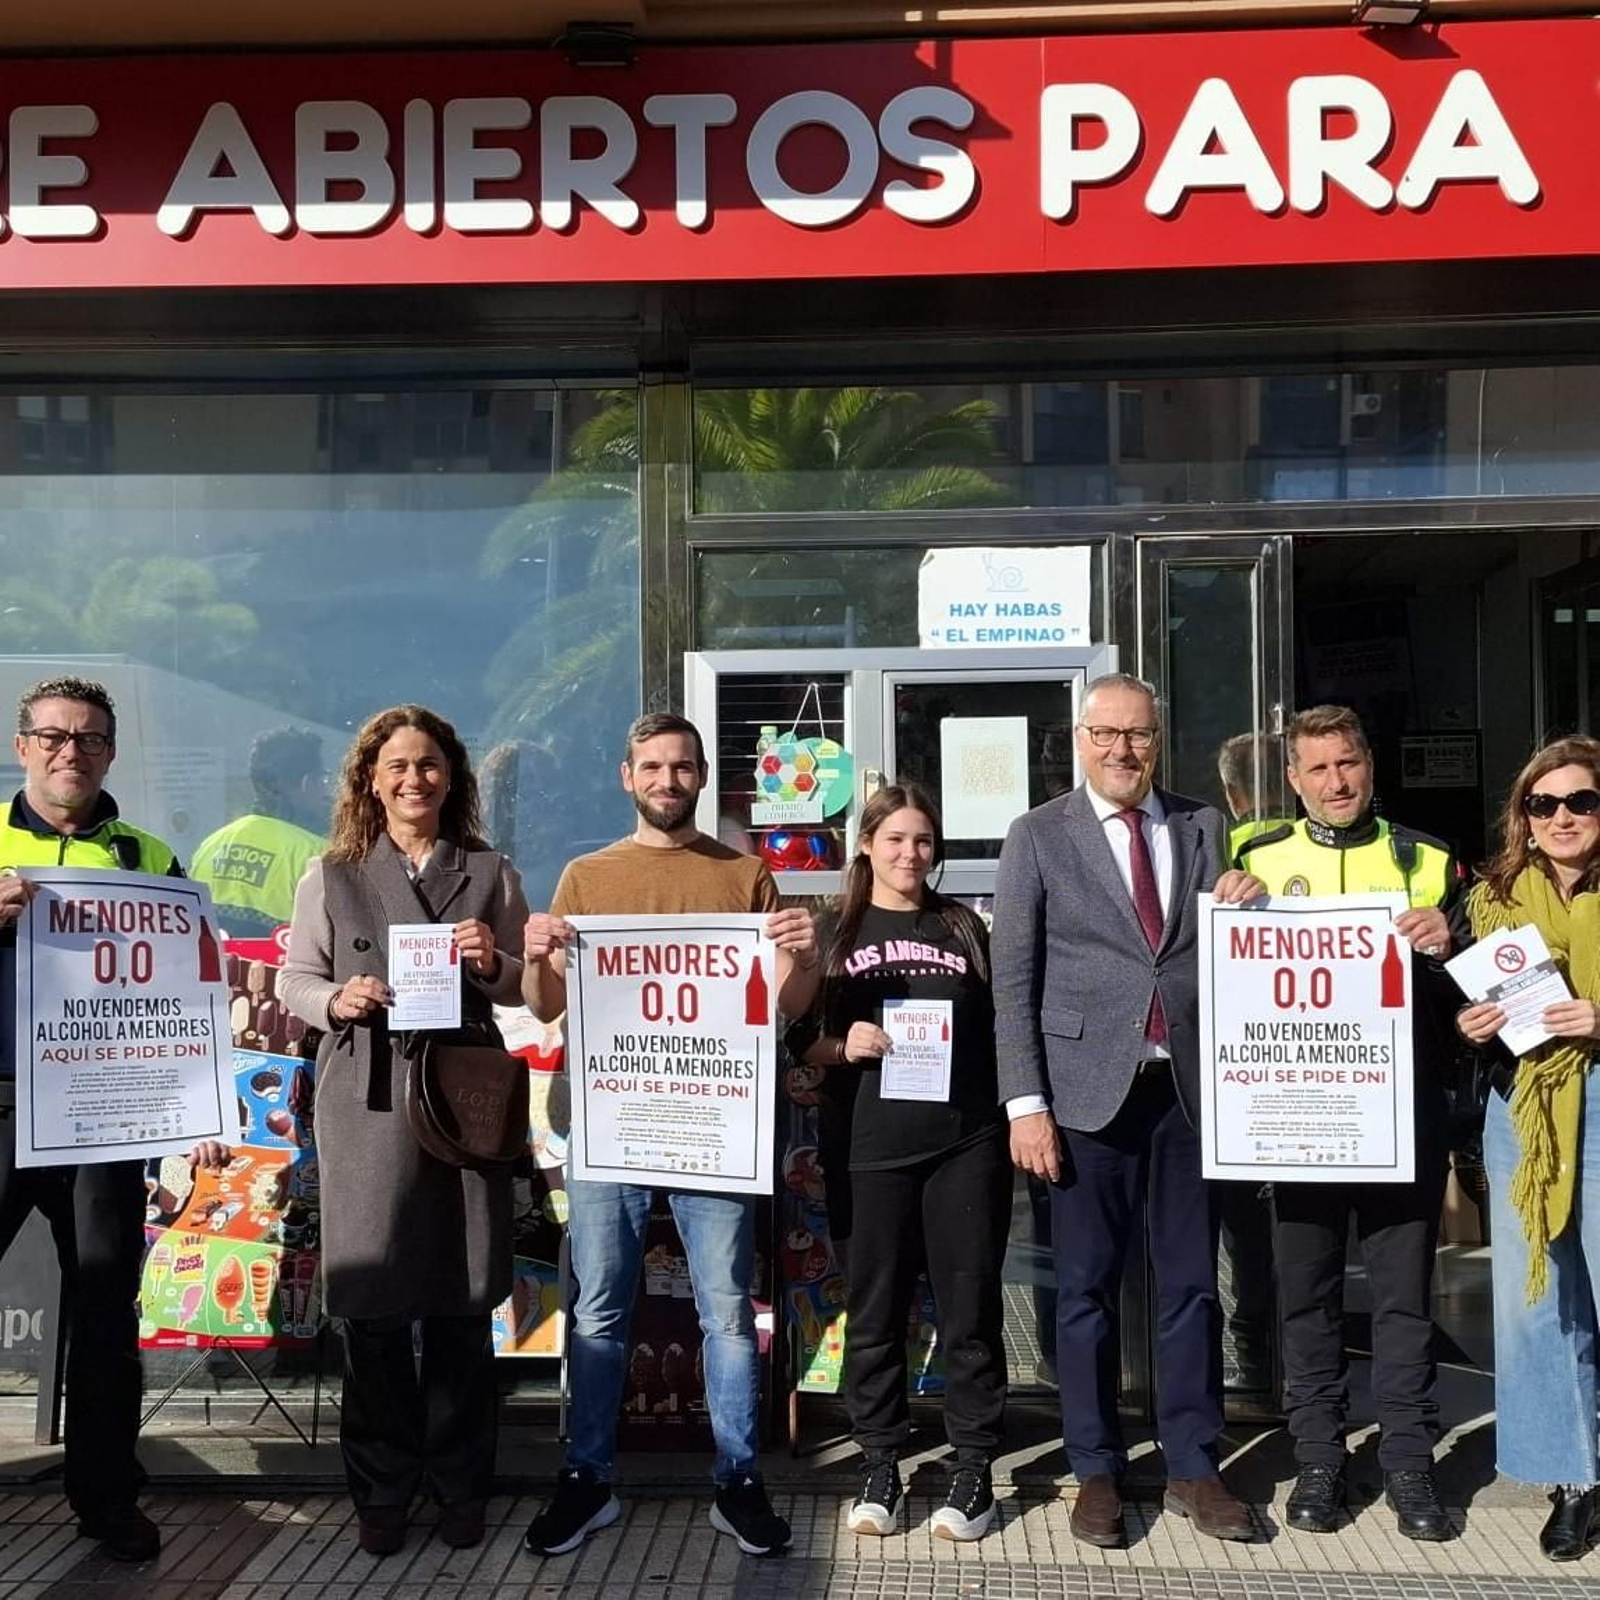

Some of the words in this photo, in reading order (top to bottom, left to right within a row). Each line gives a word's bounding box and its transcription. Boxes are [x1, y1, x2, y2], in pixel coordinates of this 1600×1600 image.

[0, 104, 100, 238] E
[156, 86, 977, 236] ABIERTOS
[1041, 69, 1540, 219] PARA
[950, 603, 988, 617] HAY
[995, 602, 1063, 617] HABAS
[946, 628, 969, 642] EL
[976, 628, 1065, 642] EMPINAO
[49, 899, 192, 934] MENORES
[400, 937, 448, 950] MENORES
[1230, 925, 1375, 960] MENORES
[94, 940, 154, 988] 0,0
[597, 944, 740, 978] MENORES
[845, 945, 881, 977] LOS
[885, 940, 967, 975] ANGELES
[1274, 966, 1333, 1013] 0,0
[64, 999, 86, 1019] NO
[90, 998, 181, 1018] VENDEMOS
[641, 981, 699, 1026] 0,0
[893, 1013, 940, 1025] MENORES
[37, 1021, 113, 1042] ALCOHOL
[116, 1021, 130, 1041] A
[130, 1019, 210, 1040] MENORES
[1244, 1022, 1267, 1042] NO
[1269, 1022, 1362, 1042] VENDEMOS
[41, 1045, 90, 1064] AQUÍ
[95, 1047, 118, 1061] SE
[124, 1046, 168, 1060] PIDE
[174, 1043, 207, 1058] DNI
[613, 1034, 636, 1053] NO
[639, 1035, 728, 1056] VENDEMOS
[1218, 1044, 1293, 1065] ALCOHOL
[1295, 1044, 1307, 1065] A
[1309, 1045, 1390, 1065] MENORES
[588, 1055, 660, 1075] ALCOHOL
[664, 1056, 675, 1075] A
[676, 1056, 754, 1080] MENORES
[1223, 1066, 1270, 1085] AQUÍ
[1275, 1070, 1298, 1083] SE
[1303, 1070, 1346, 1084] PIDE
[1352, 1071, 1386, 1084] DNI
[592, 1078, 638, 1094] AQUÍ
[643, 1080, 665, 1094] SE
[670, 1081, 712, 1097] PIDE
[717, 1084, 750, 1099] DNI
